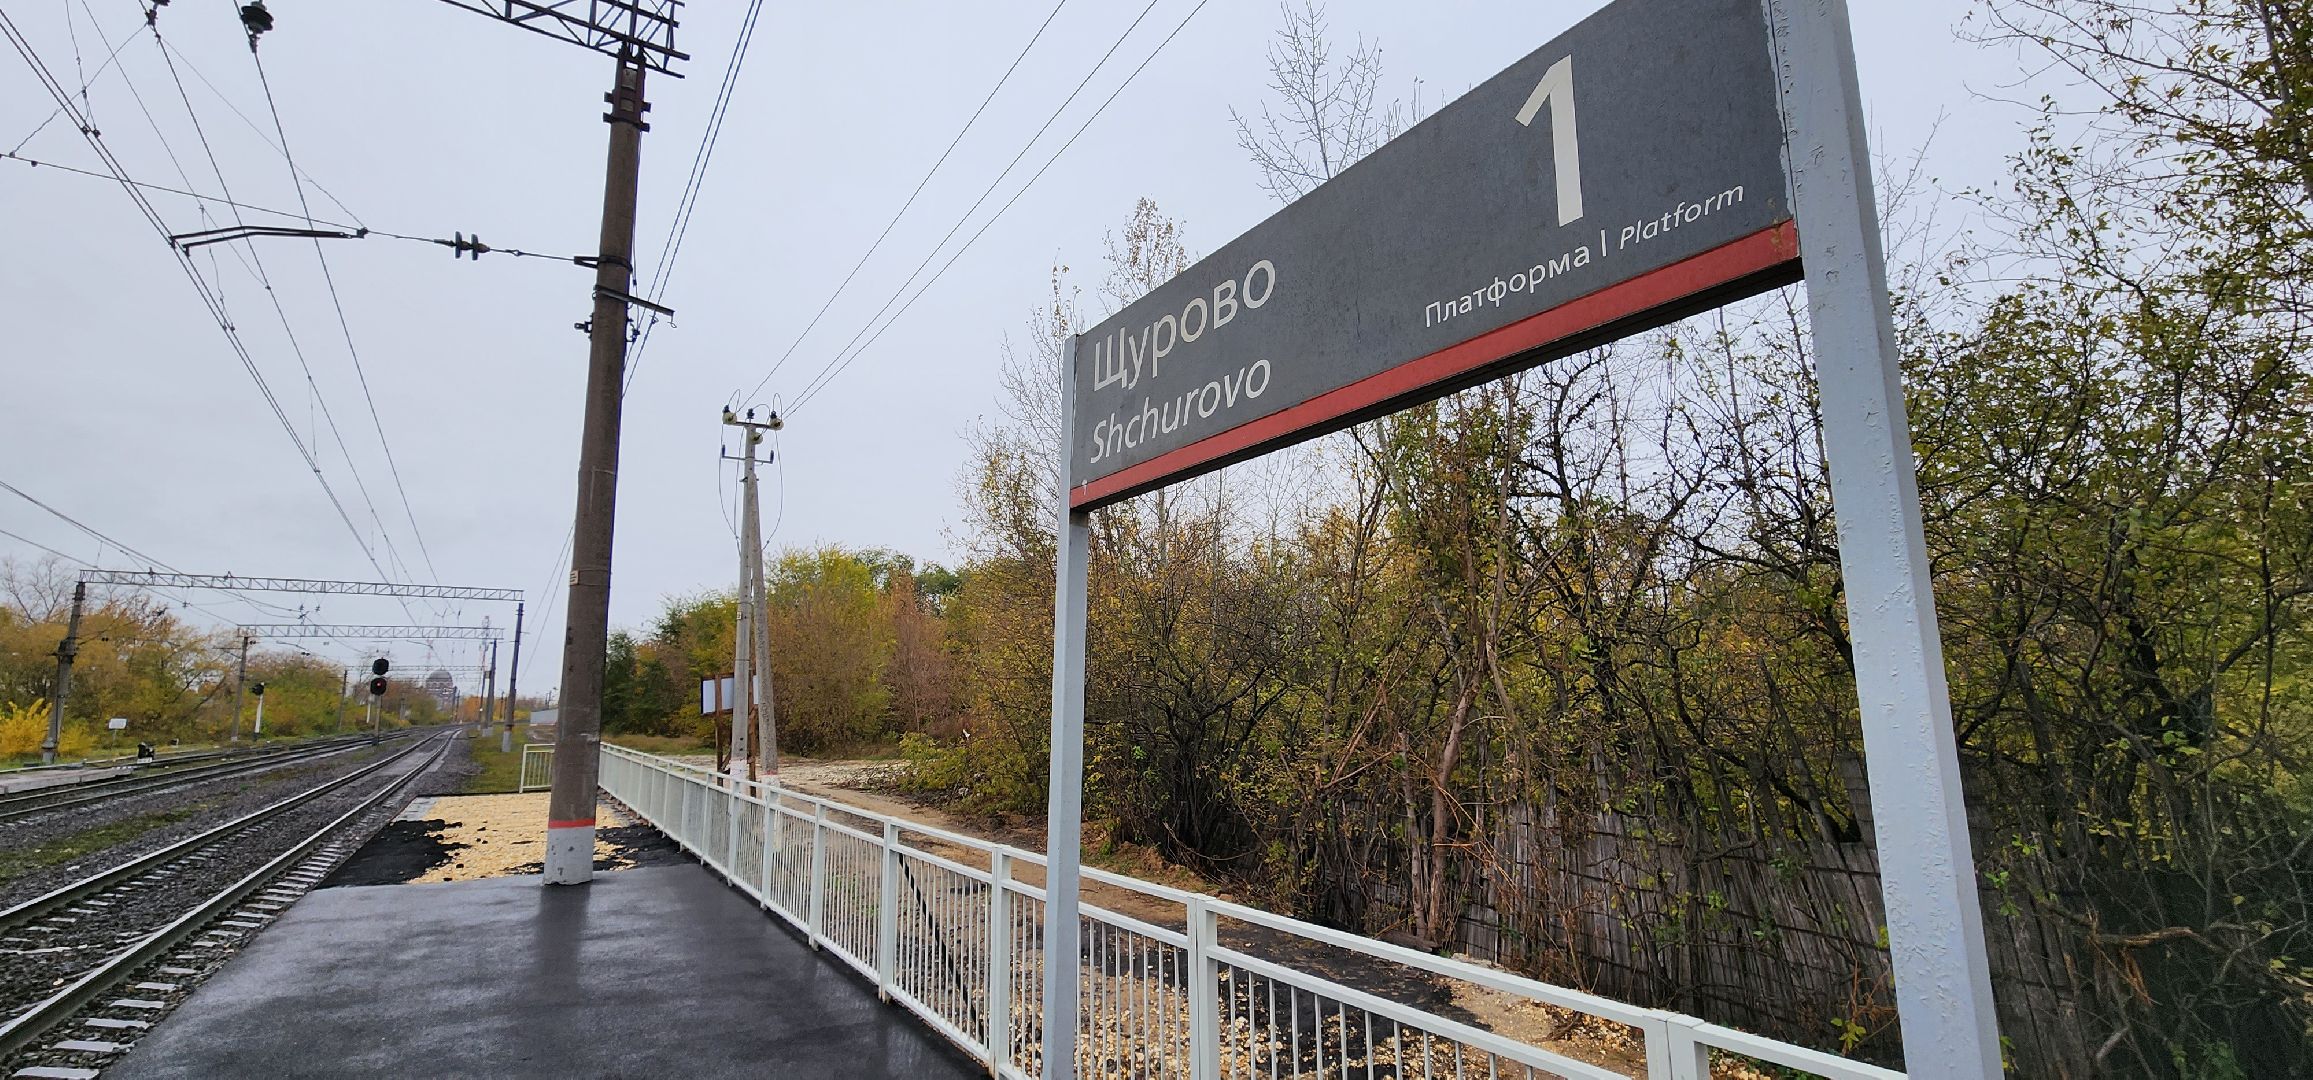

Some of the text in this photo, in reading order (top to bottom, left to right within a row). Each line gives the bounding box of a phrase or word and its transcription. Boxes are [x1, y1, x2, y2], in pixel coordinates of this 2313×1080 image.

[1515, 55, 1583, 227] 1
[1425, 185, 1744, 328] Платформа Platform
[1093, 260, 1276, 391] Щурово
[1090, 359, 1271, 463] Shchurovo
